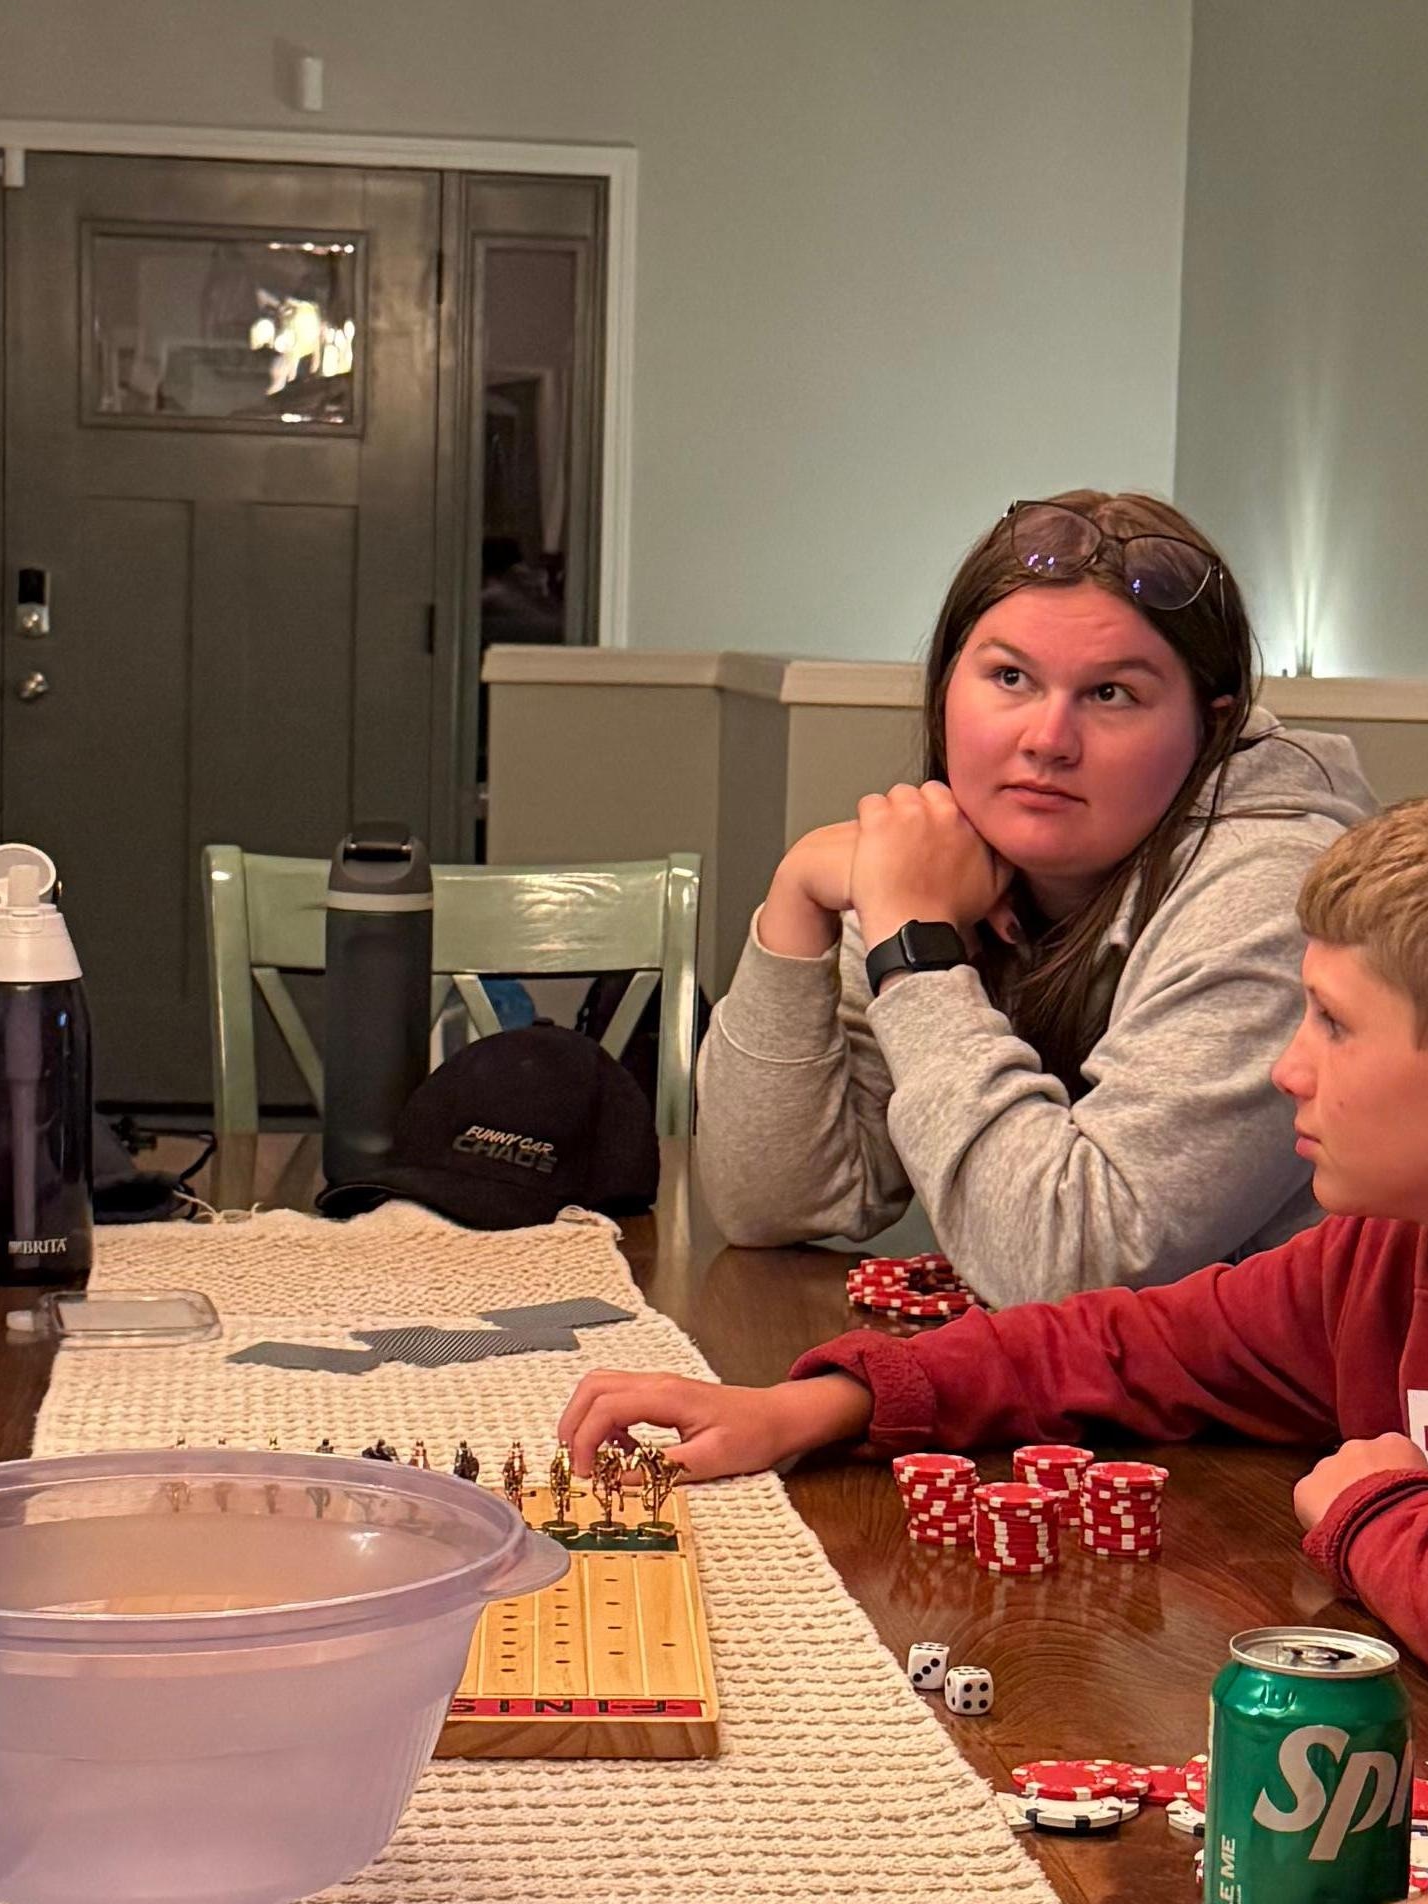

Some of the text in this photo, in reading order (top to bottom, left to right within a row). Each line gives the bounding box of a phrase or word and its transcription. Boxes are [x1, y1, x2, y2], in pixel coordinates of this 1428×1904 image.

[465, 1125, 523, 1146] FUNNY
[22, 1237, 68, 1254] BRITA
[1220, 1834, 1236, 1880] ME
